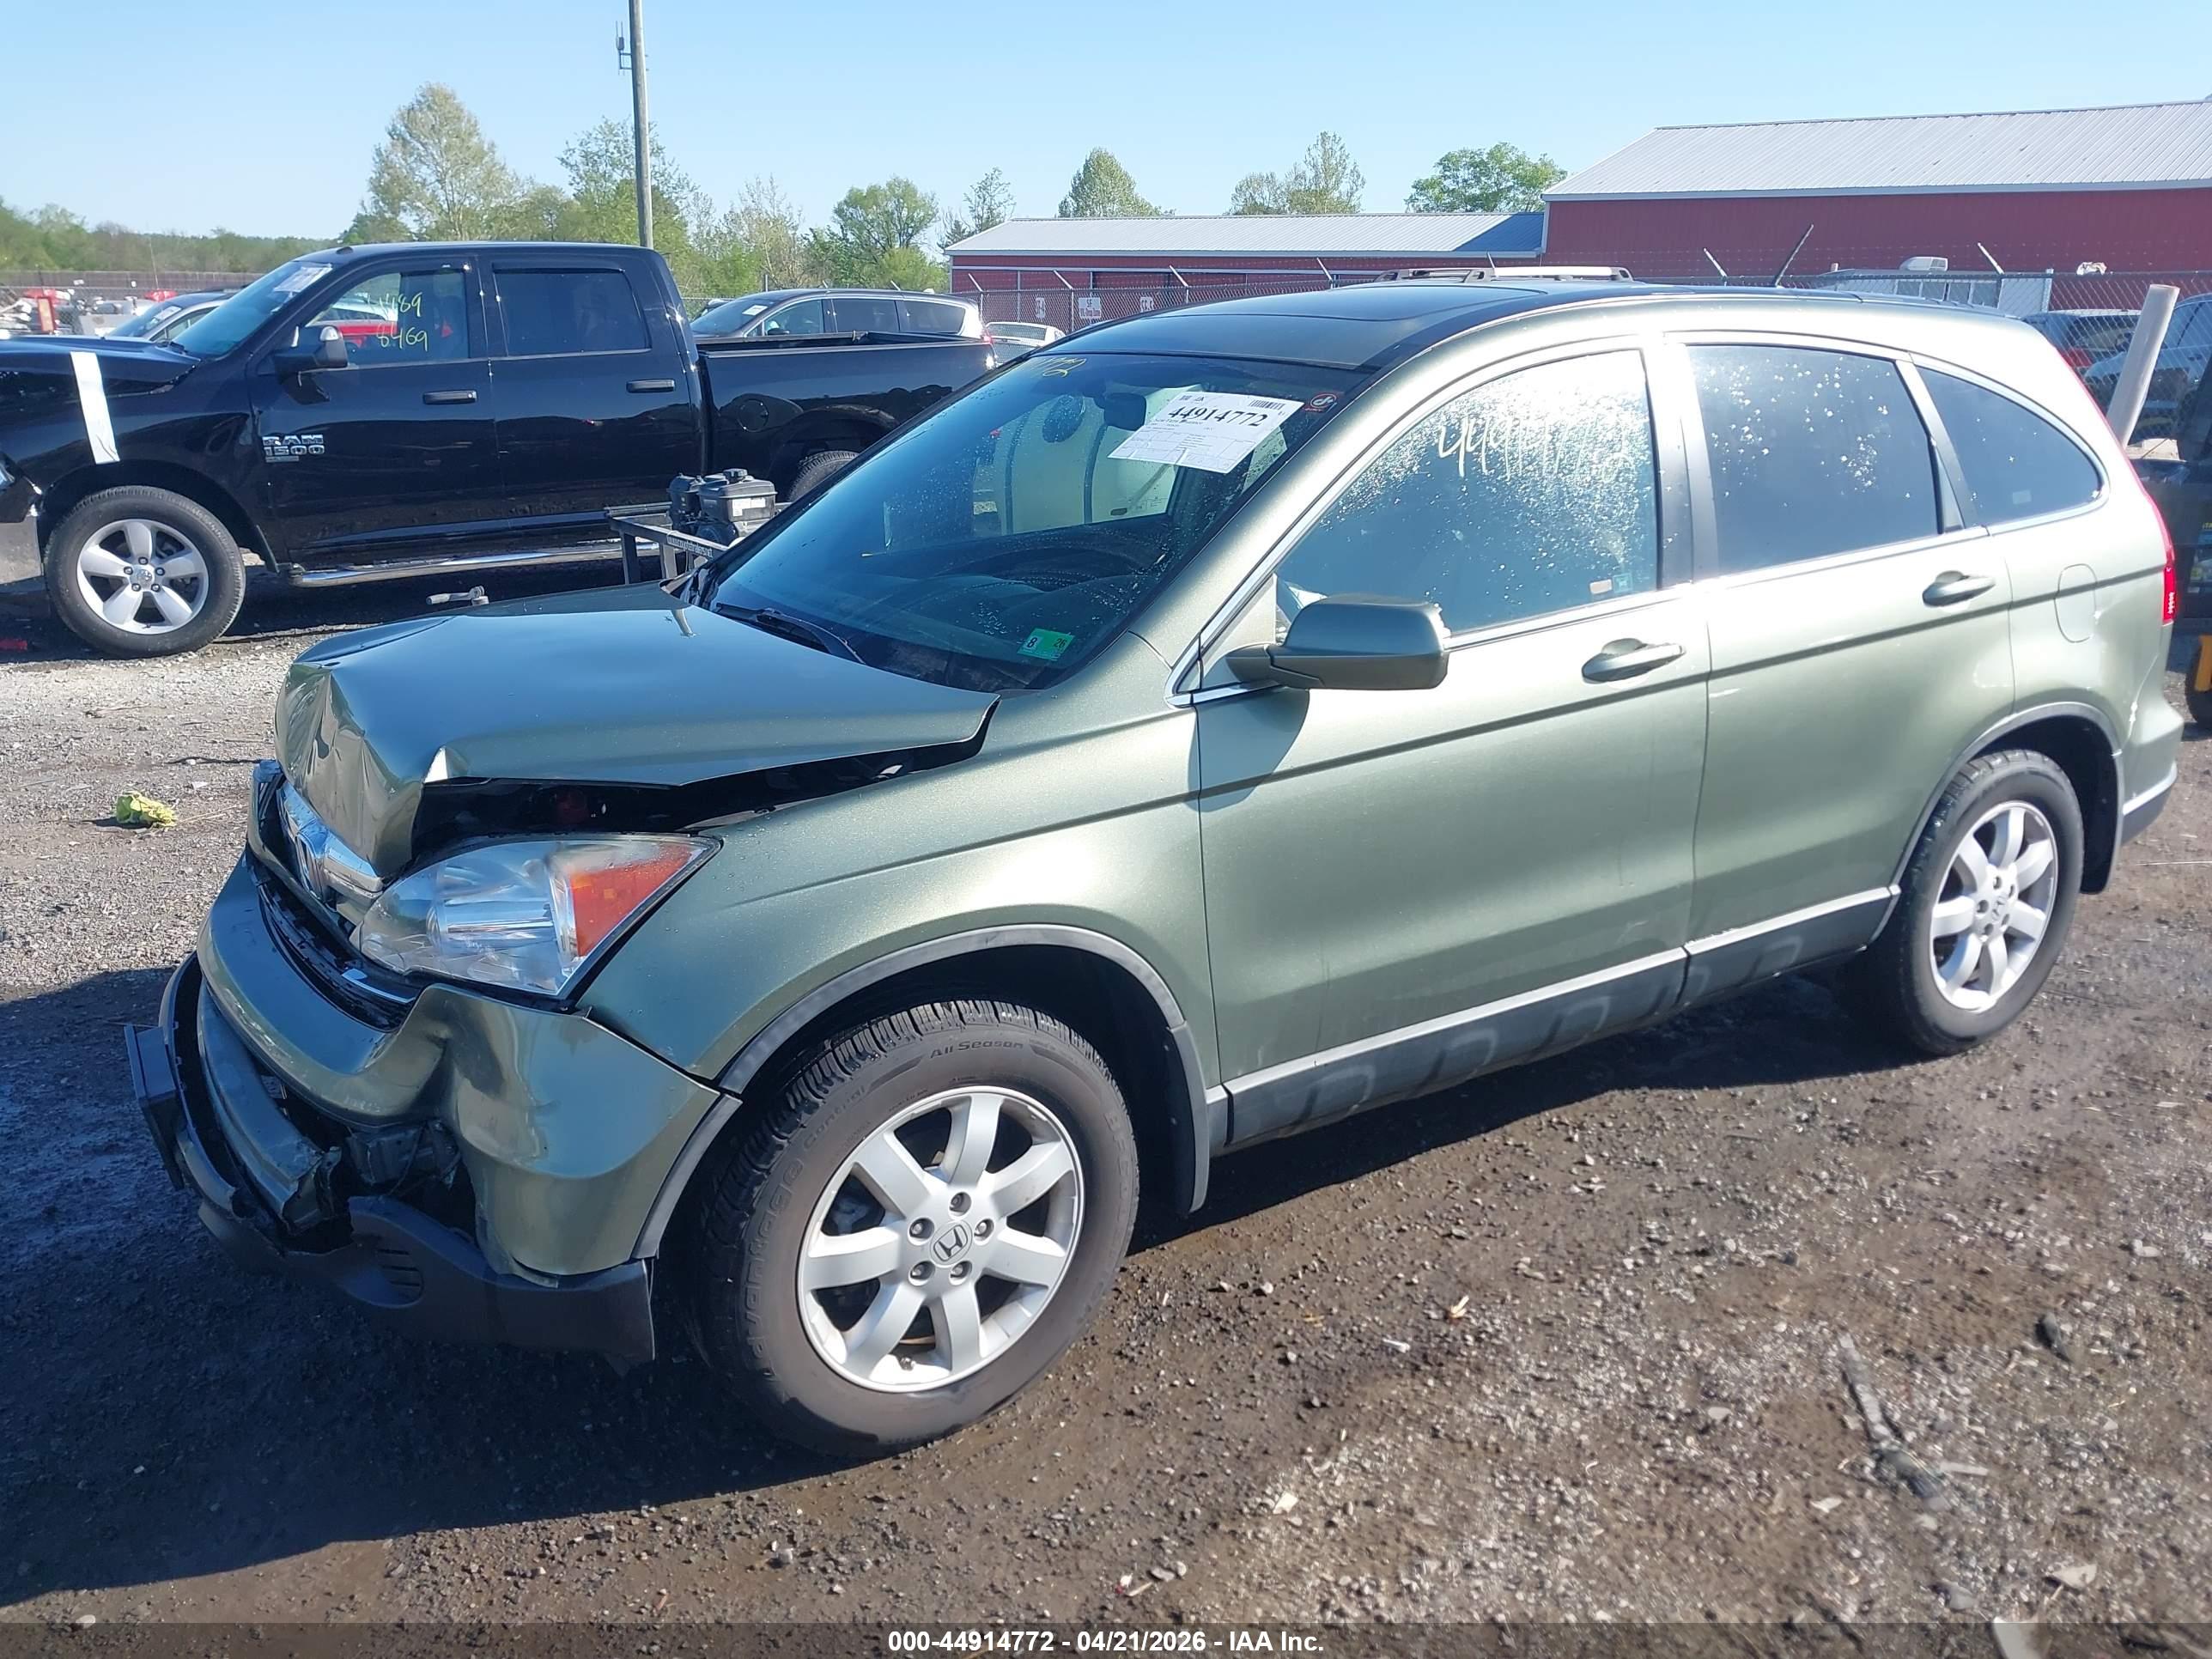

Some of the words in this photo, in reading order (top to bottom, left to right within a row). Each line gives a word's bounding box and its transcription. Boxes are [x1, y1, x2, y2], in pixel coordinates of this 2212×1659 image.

[1168, 406, 1268, 427] 44914772
[262, 434, 324, 446] RAM
[264, 445, 325, 456] 1500
[1026, 636, 1038, 648] 8
[930, 1044, 954, 1059] All
[957, 1040, 1024, 1052] Season
